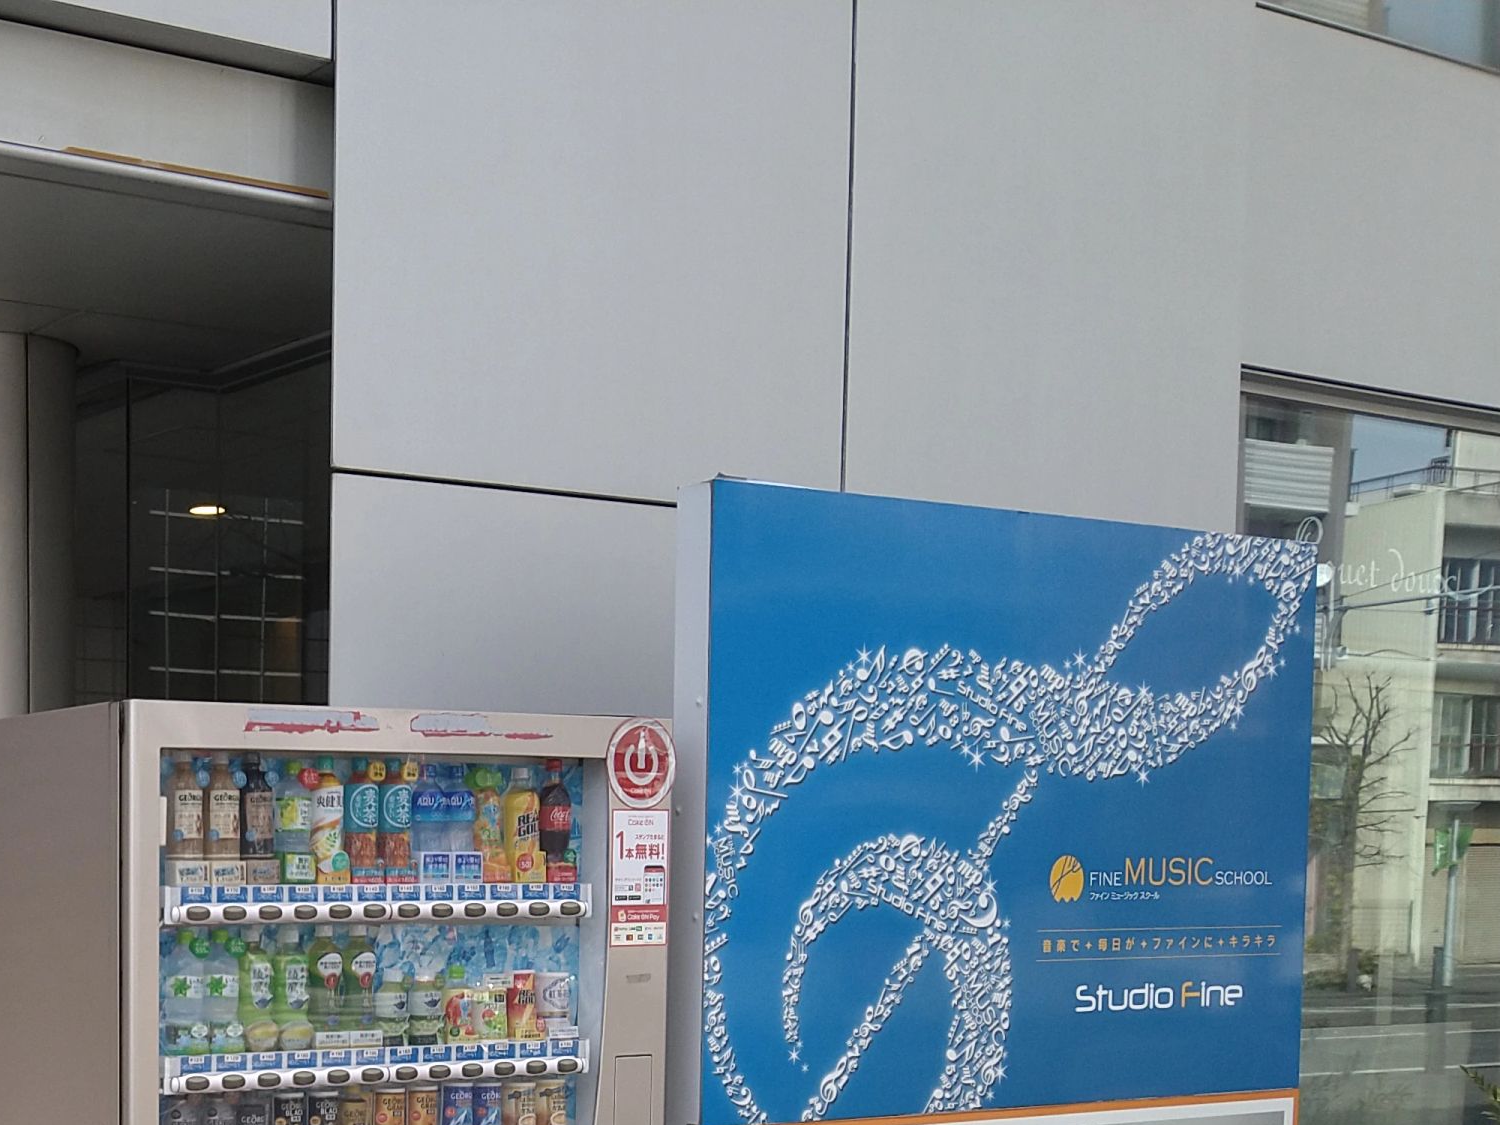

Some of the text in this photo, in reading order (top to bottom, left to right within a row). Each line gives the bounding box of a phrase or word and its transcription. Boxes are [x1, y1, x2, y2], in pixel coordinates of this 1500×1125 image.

[957, 680, 1027, 732] Studio Fine
[1035, 701, 1072, 777] MUSIC
[1089, 857, 1273, 887] FINE MUSIC SCHOOL
[866, 878, 948, 932] Studio Fine
[967, 972, 1005, 1046] MUSIC
[1075, 980, 1243, 1013] Studio Fine
